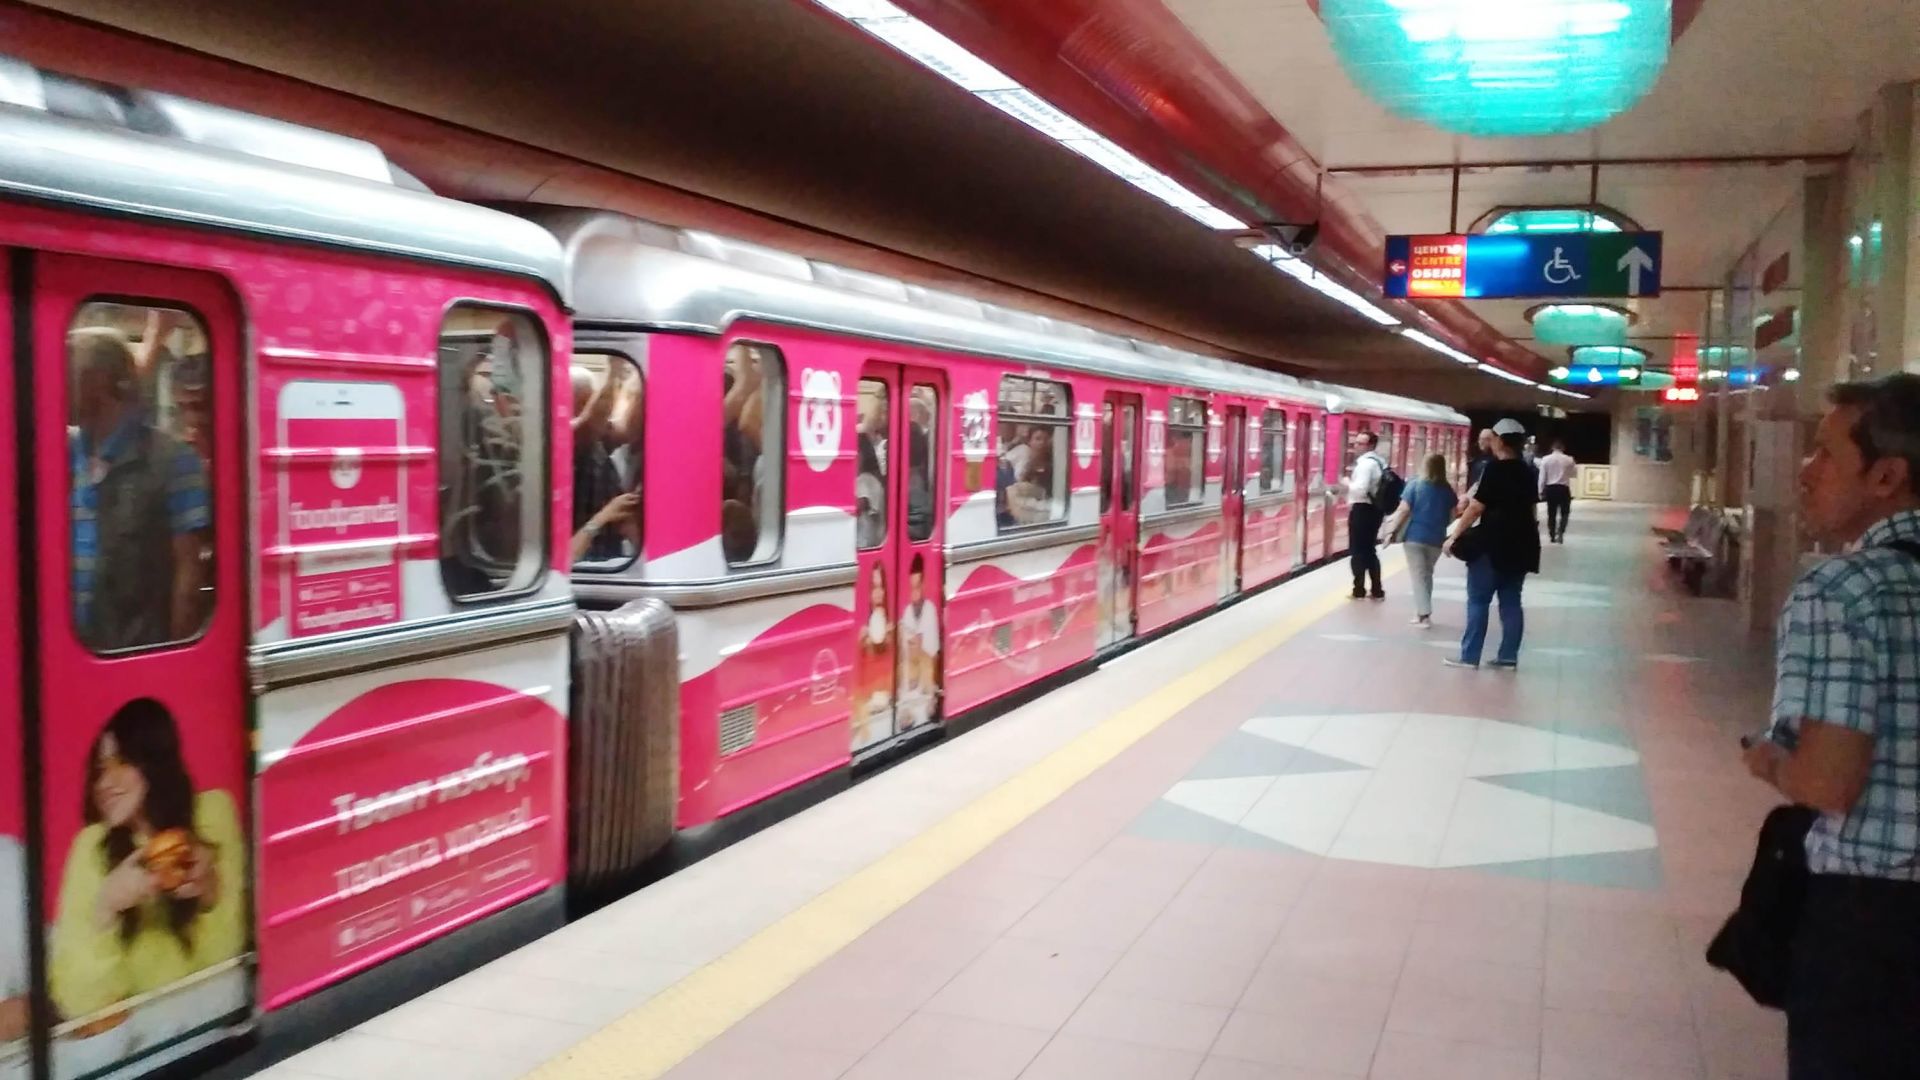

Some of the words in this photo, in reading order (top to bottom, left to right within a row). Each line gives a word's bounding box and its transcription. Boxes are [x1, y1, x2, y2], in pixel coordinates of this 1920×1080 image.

[1413, 245, 1462, 255] ЦЕНТ
[1414, 256, 1461, 266] CENTRE
[1411, 268, 1461, 279] ОБЕЛЯ
